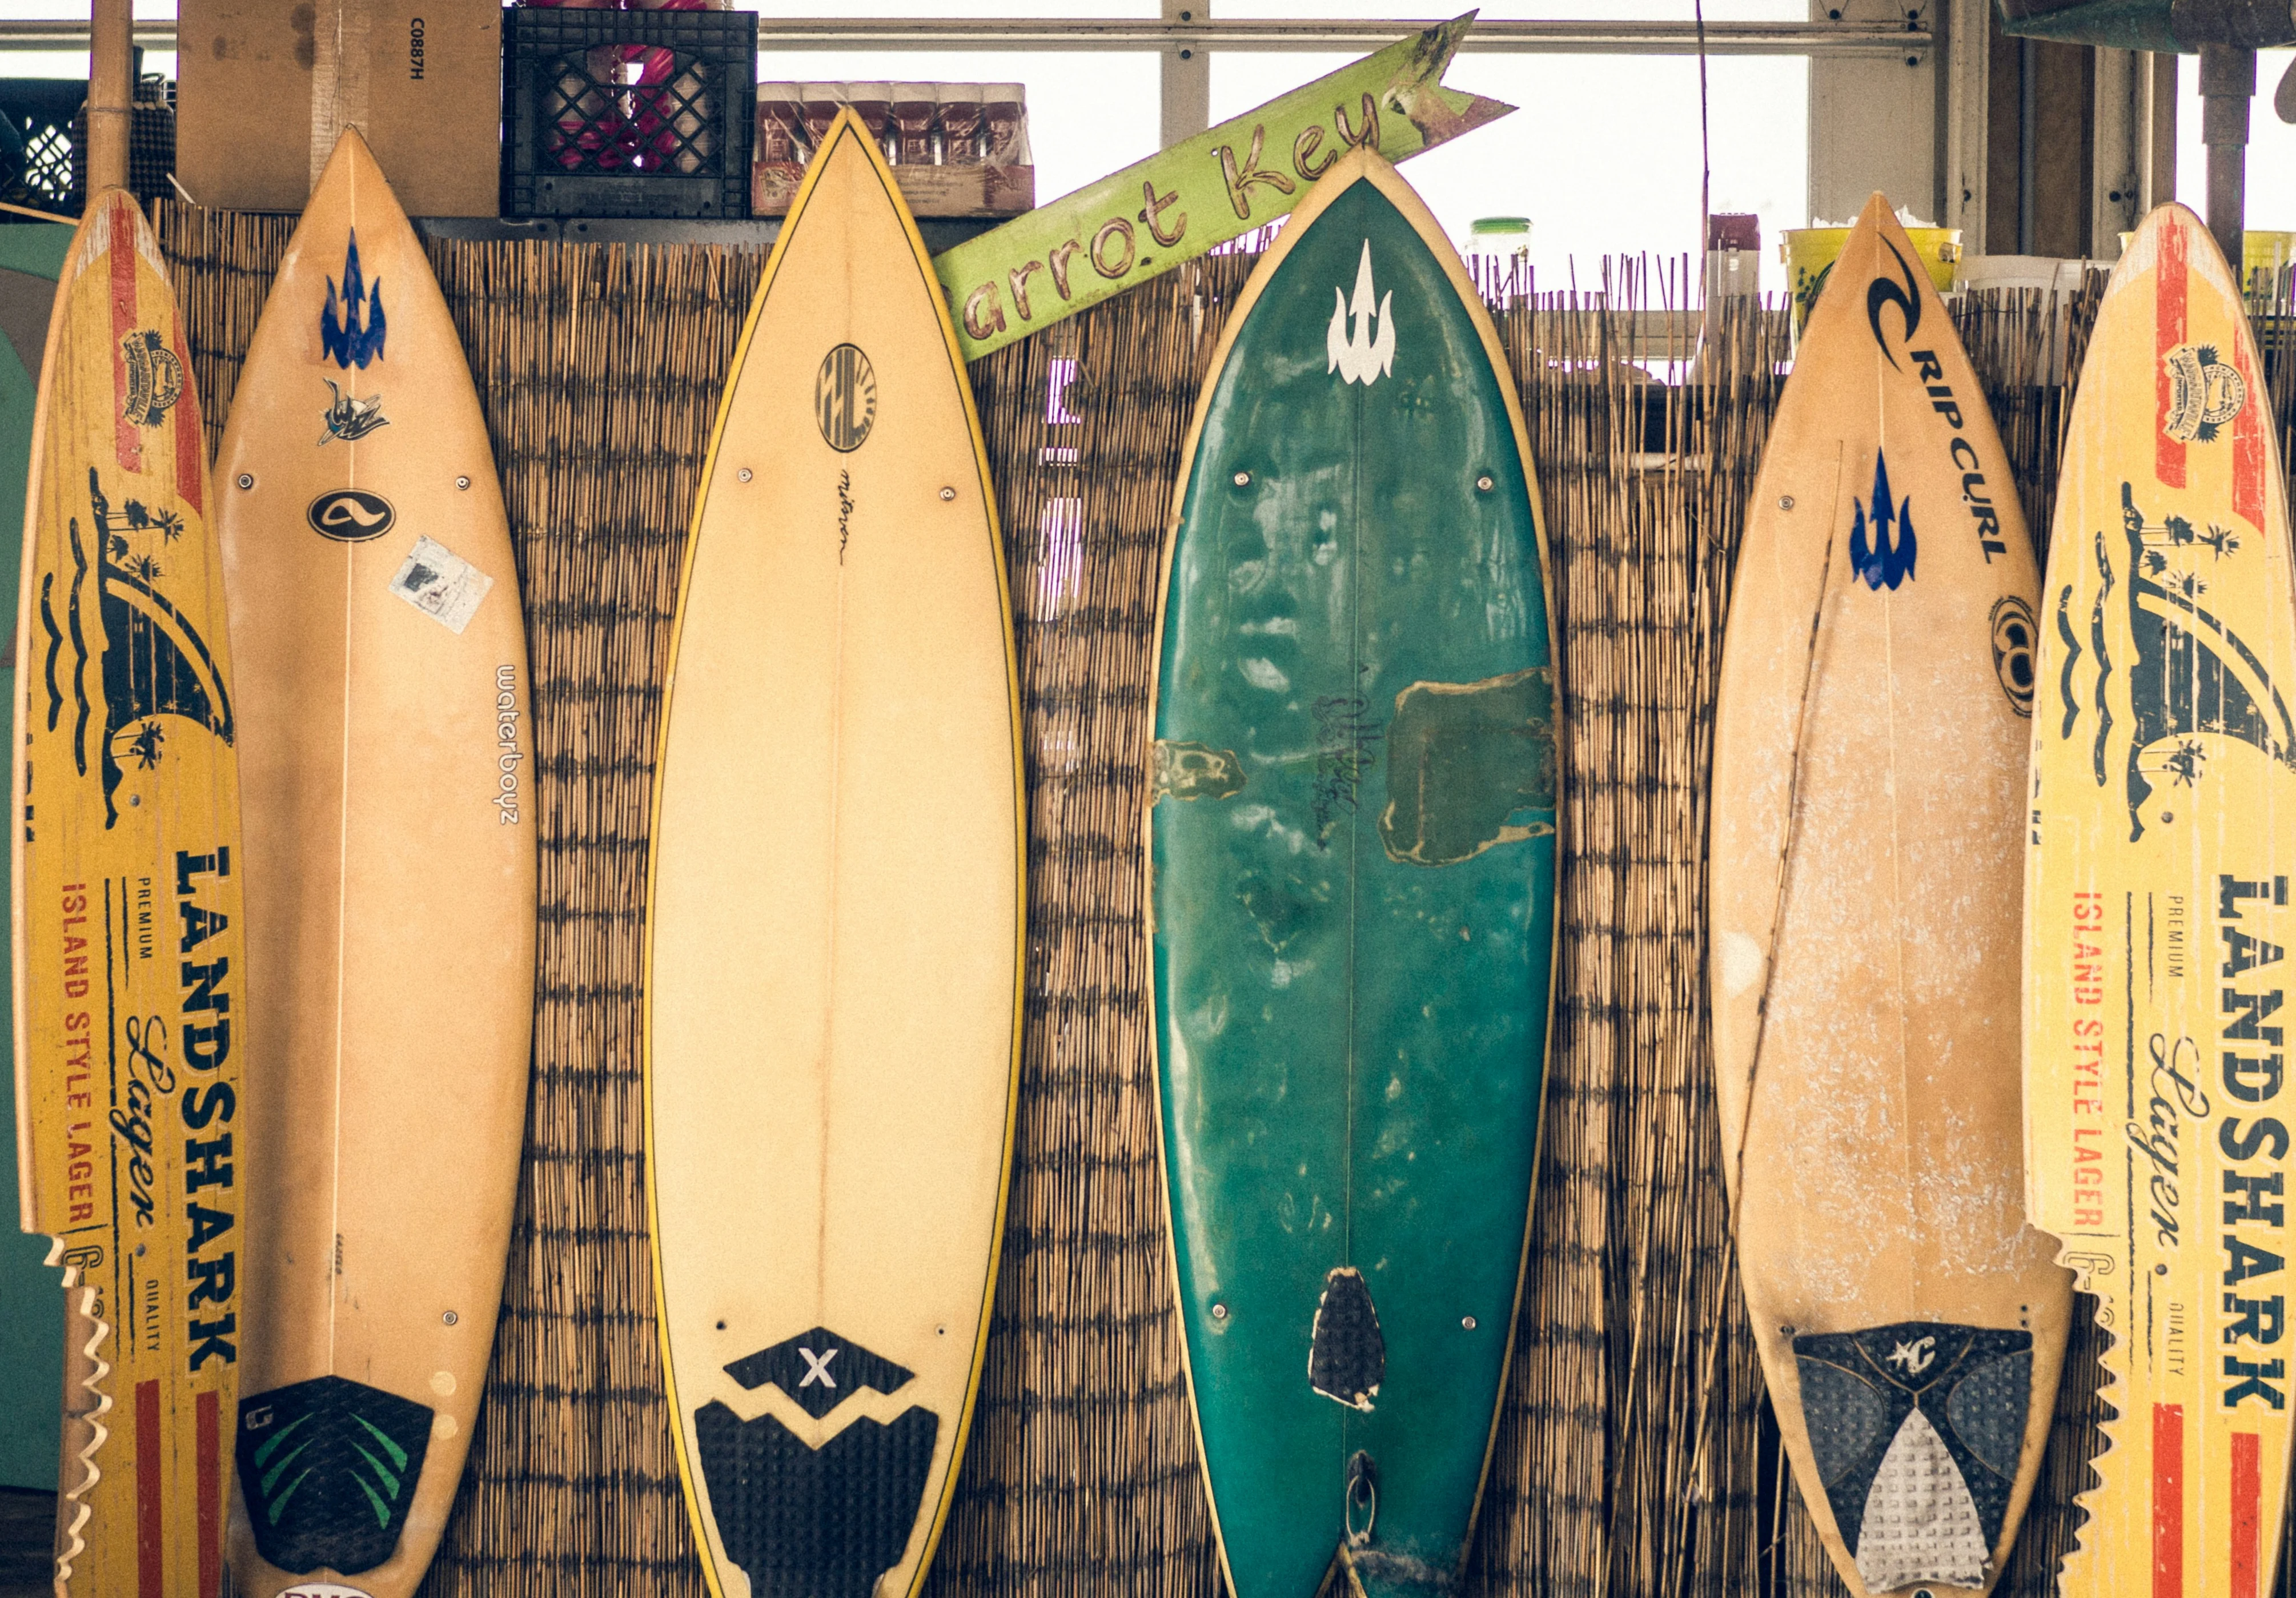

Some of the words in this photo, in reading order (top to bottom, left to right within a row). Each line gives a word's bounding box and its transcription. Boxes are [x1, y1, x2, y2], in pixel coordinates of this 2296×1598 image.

[411, 18, 425, 80] C0887H
[942, 181, 1187, 340] arrot
[1221, 93, 1380, 220] Key
[1910, 350, 1964, 430] RIP
[1950, 436, 2008, 565] CURL
[492, 665, 524, 825] waterboyz
[62, 883, 90, 998] ISLAND
[138, 878, 153, 959] PREMIUM
[2073, 892, 2104, 1005] ISLAND
[2168, 896, 2184, 978] PREMIUM
[65, 1012, 92, 1109] STYLE
[176, 846, 237, 1372] LANDSHARK
[2073, 1019, 2104, 1114] STYLE
[109, 1014, 175, 1226] Lager
[2125, 1033, 2210, 1248] Lager
[2218, 874, 2290, 1410] LANDSHARK
[67, 1122, 93, 1222] LAGER
[2073, 1129, 2104, 1227] LAGER
[146, 1279, 160, 1352] QUALITY
[2168, 1303, 2185, 1376] QUALITY
[798, 1347, 838, 1388] X
